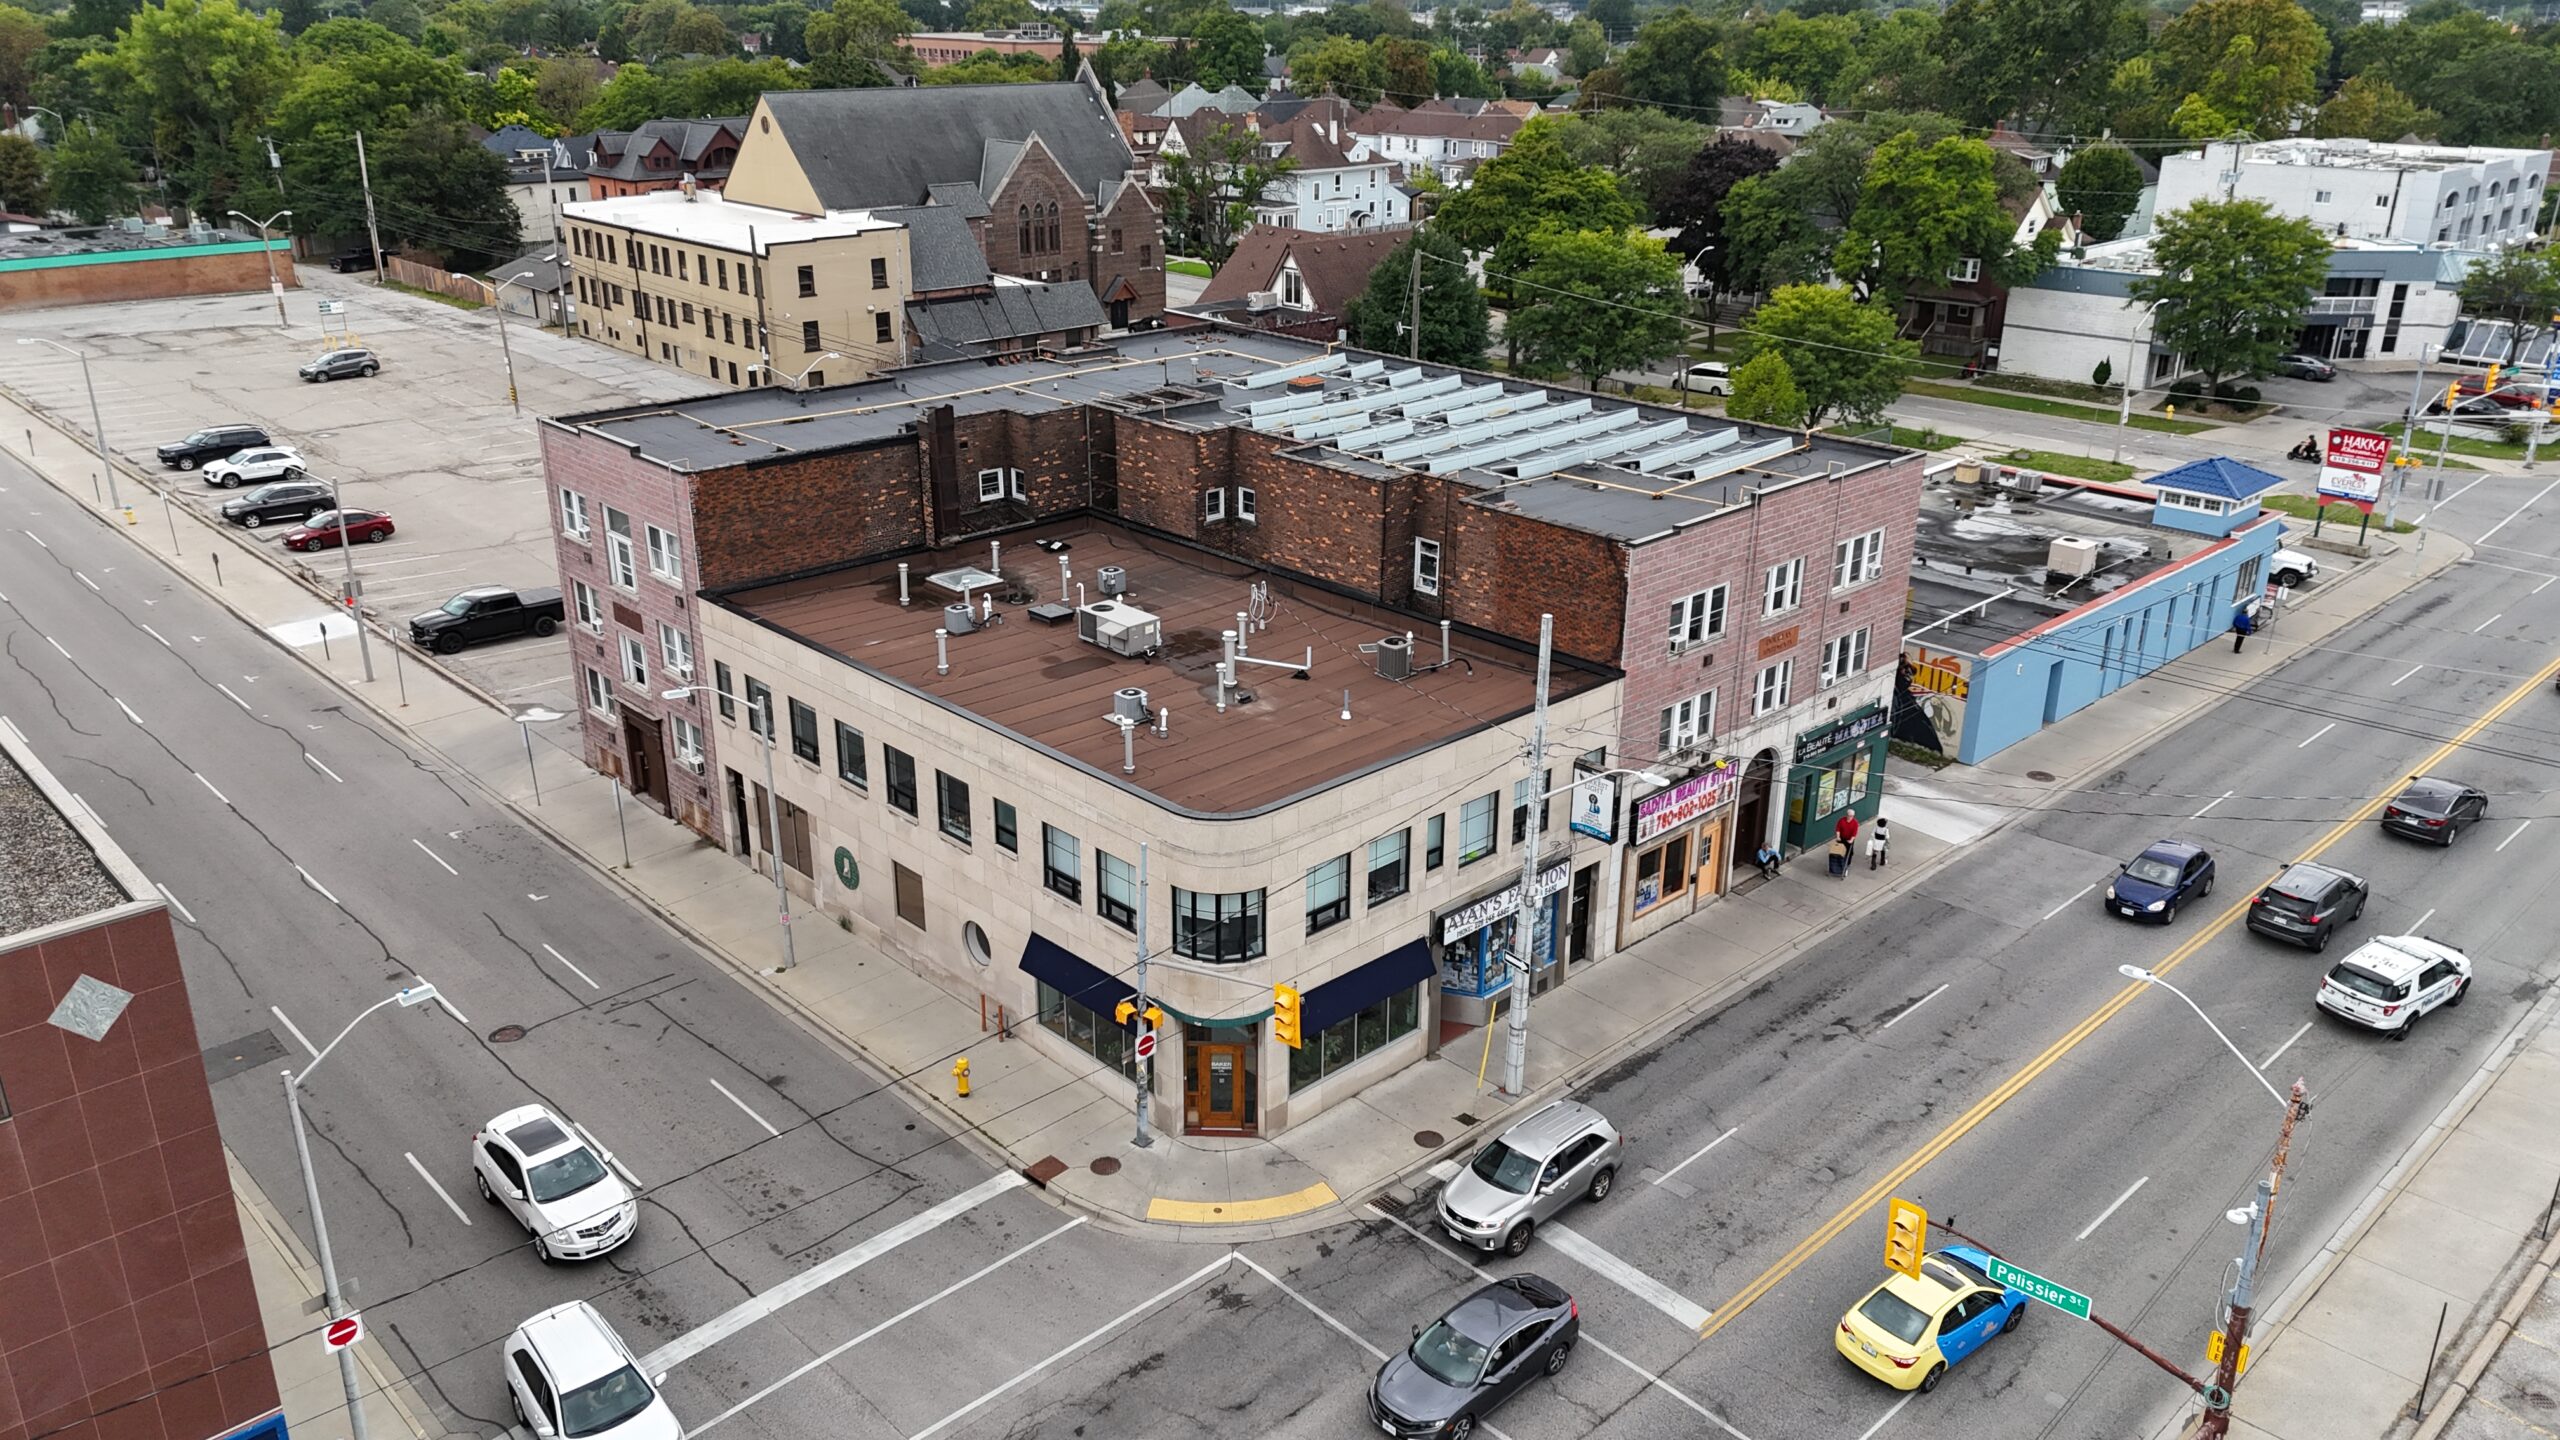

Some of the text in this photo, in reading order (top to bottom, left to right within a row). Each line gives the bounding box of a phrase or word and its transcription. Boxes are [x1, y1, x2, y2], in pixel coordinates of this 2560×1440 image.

[2343, 435, 2386, 453] HAKKA
[1638, 762, 1737, 820] SADIYA BEAUTY STYLE
[1446, 894, 1503, 934] AYAN'S
[1996, 1264, 2085, 1308] Pelissier St.
